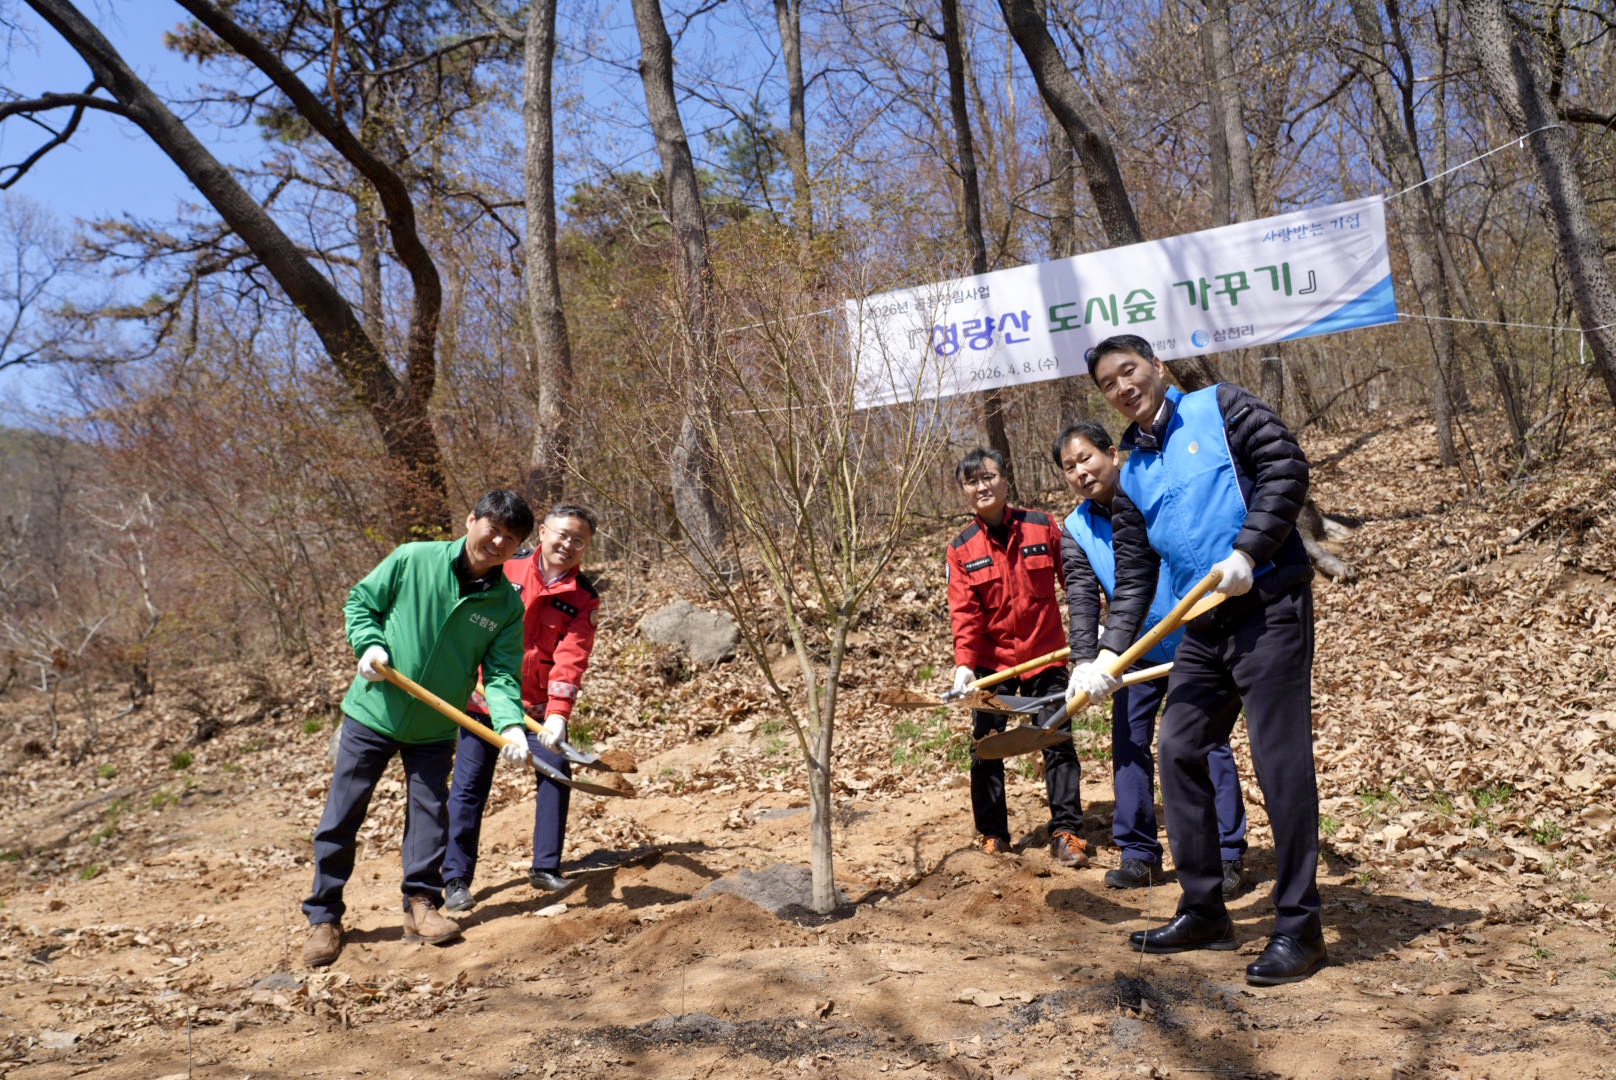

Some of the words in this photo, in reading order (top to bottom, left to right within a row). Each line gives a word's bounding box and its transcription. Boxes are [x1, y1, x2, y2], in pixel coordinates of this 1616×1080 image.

[1263, 221, 1325, 242] 사랑받는
[1330, 213, 1360, 230] 기업
[1048, 288, 1158, 333] 도시숲
[1172, 261, 1317, 311] 가꾸기』
[1213, 324, 1255, 343] 삼천리
[970, 366, 1005, 382] 2026.
[1008, 363, 1020, 376] 4.
[1023, 360, 1035, 374] 8.
[1038, 356, 1059, 372] (수)
[469, 612, 498, 632] 산림청
